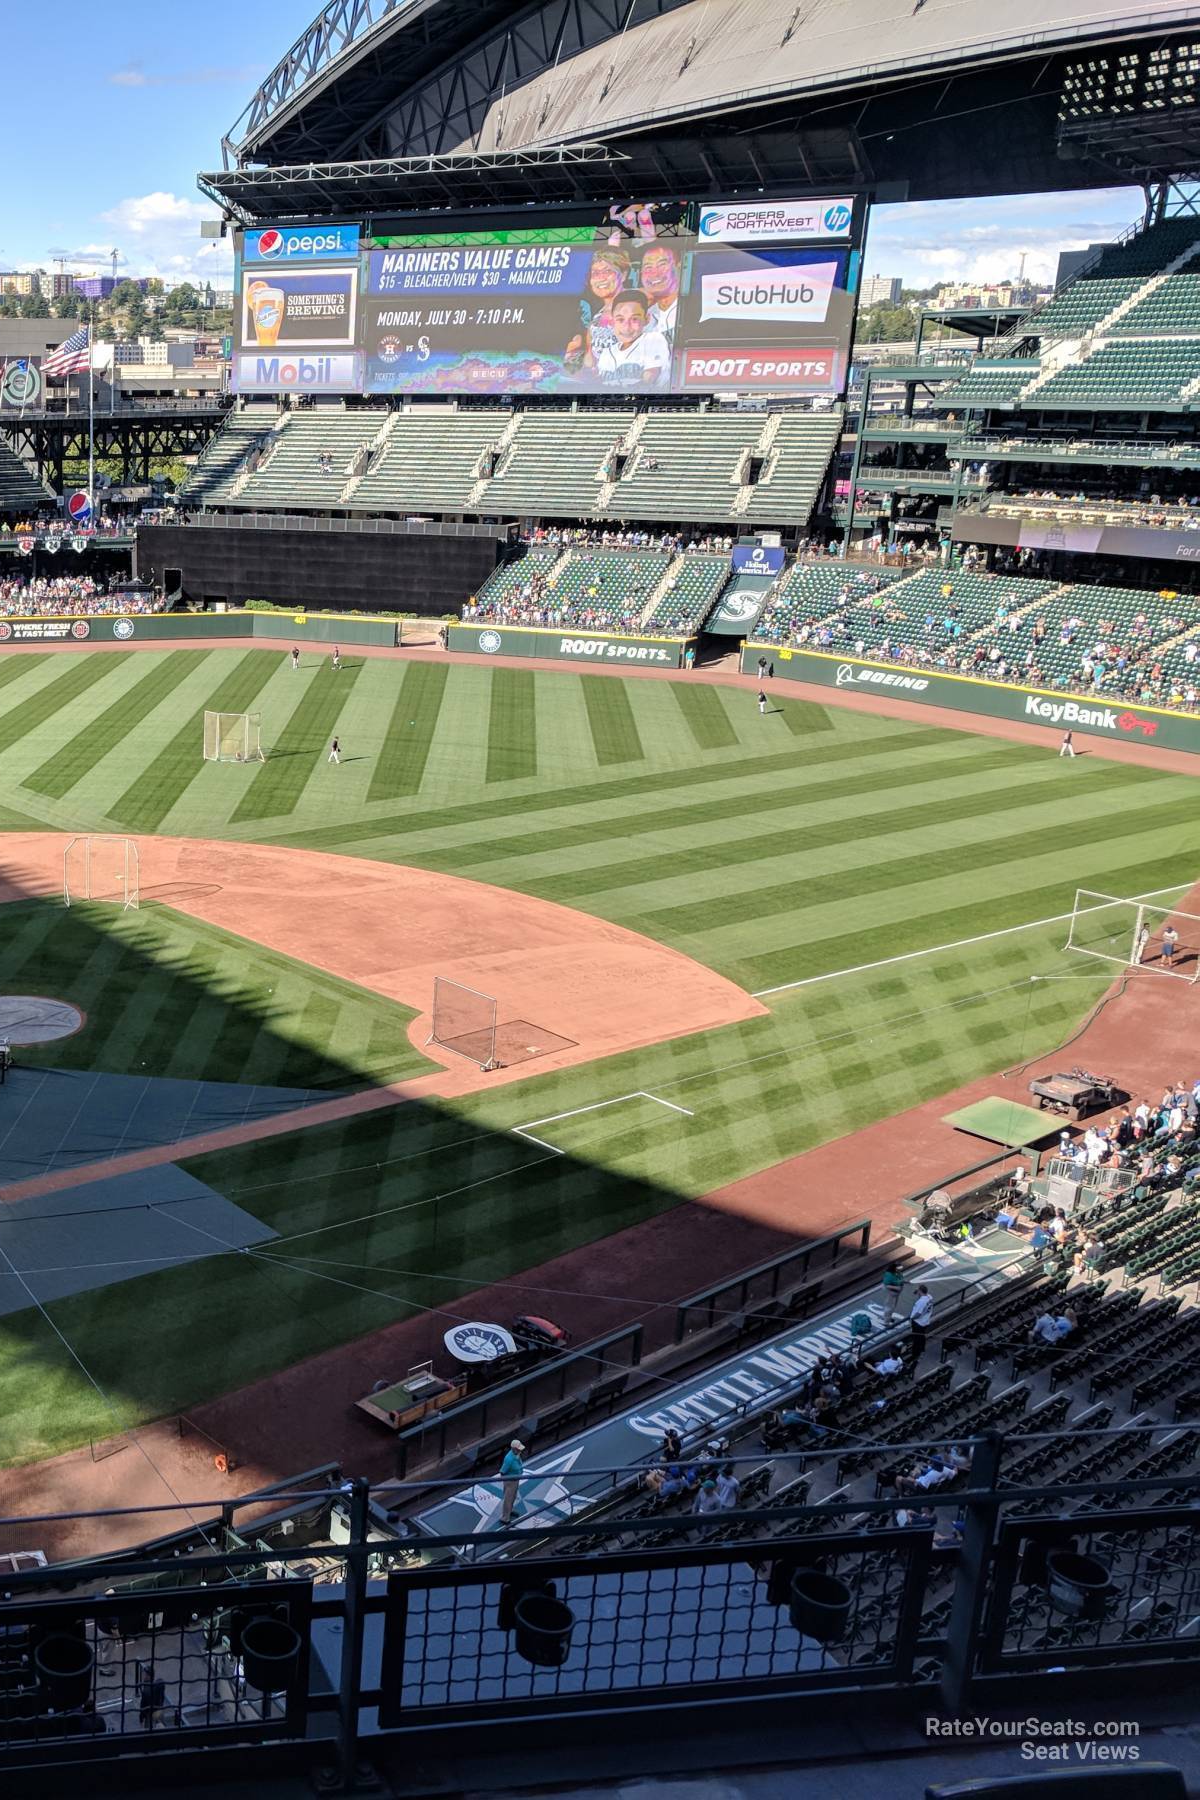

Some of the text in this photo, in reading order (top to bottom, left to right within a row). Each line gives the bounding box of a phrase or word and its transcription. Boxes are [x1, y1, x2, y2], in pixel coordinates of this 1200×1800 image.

[726, 218, 813, 229] NORTHWEST
[727, 211, 785, 221] COPIERS
[829, 206, 850, 231] hp
[287, 231, 342, 255] pepsi
[381, 247, 571, 273] MARINERS VALUE GAMES
[379, 274, 396, 291] $15
[403, 272, 478, 288] BLEACHER/VIEW
[481, 270, 500, 288] $30
[508, 269, 562, 285] MAIN/CLUB
[288, 294, 345, 306] SOMETHING'S
[717, 284, 814, 305] StubHub
[287, 306, 345, 316] BREWING
[377, 311, 422, 327] MONDAY,
[425, 310, 451, 326] JULY
[453, 310, 467, 325] 30
[475, 309, 500, 325] 7:10
[502, 309, 525, 325] P.M.
[256, 358, 331, 384] Mobil
[689, 359, 826, 377] ROOT SPORTS
[49, 542, 58, 550] 24
[1176, 545, 1194, 557] For
[13, 623, 43, 631] WHERE
[43, 622, 71, 630] FRESH
[22, 630, 43, 638] FAST
[560, 638, 666, 661] ROOT SPORTS
[858, 669, 929, 691] BOEING
[1025, 696, 1118, 729] KeyBank
